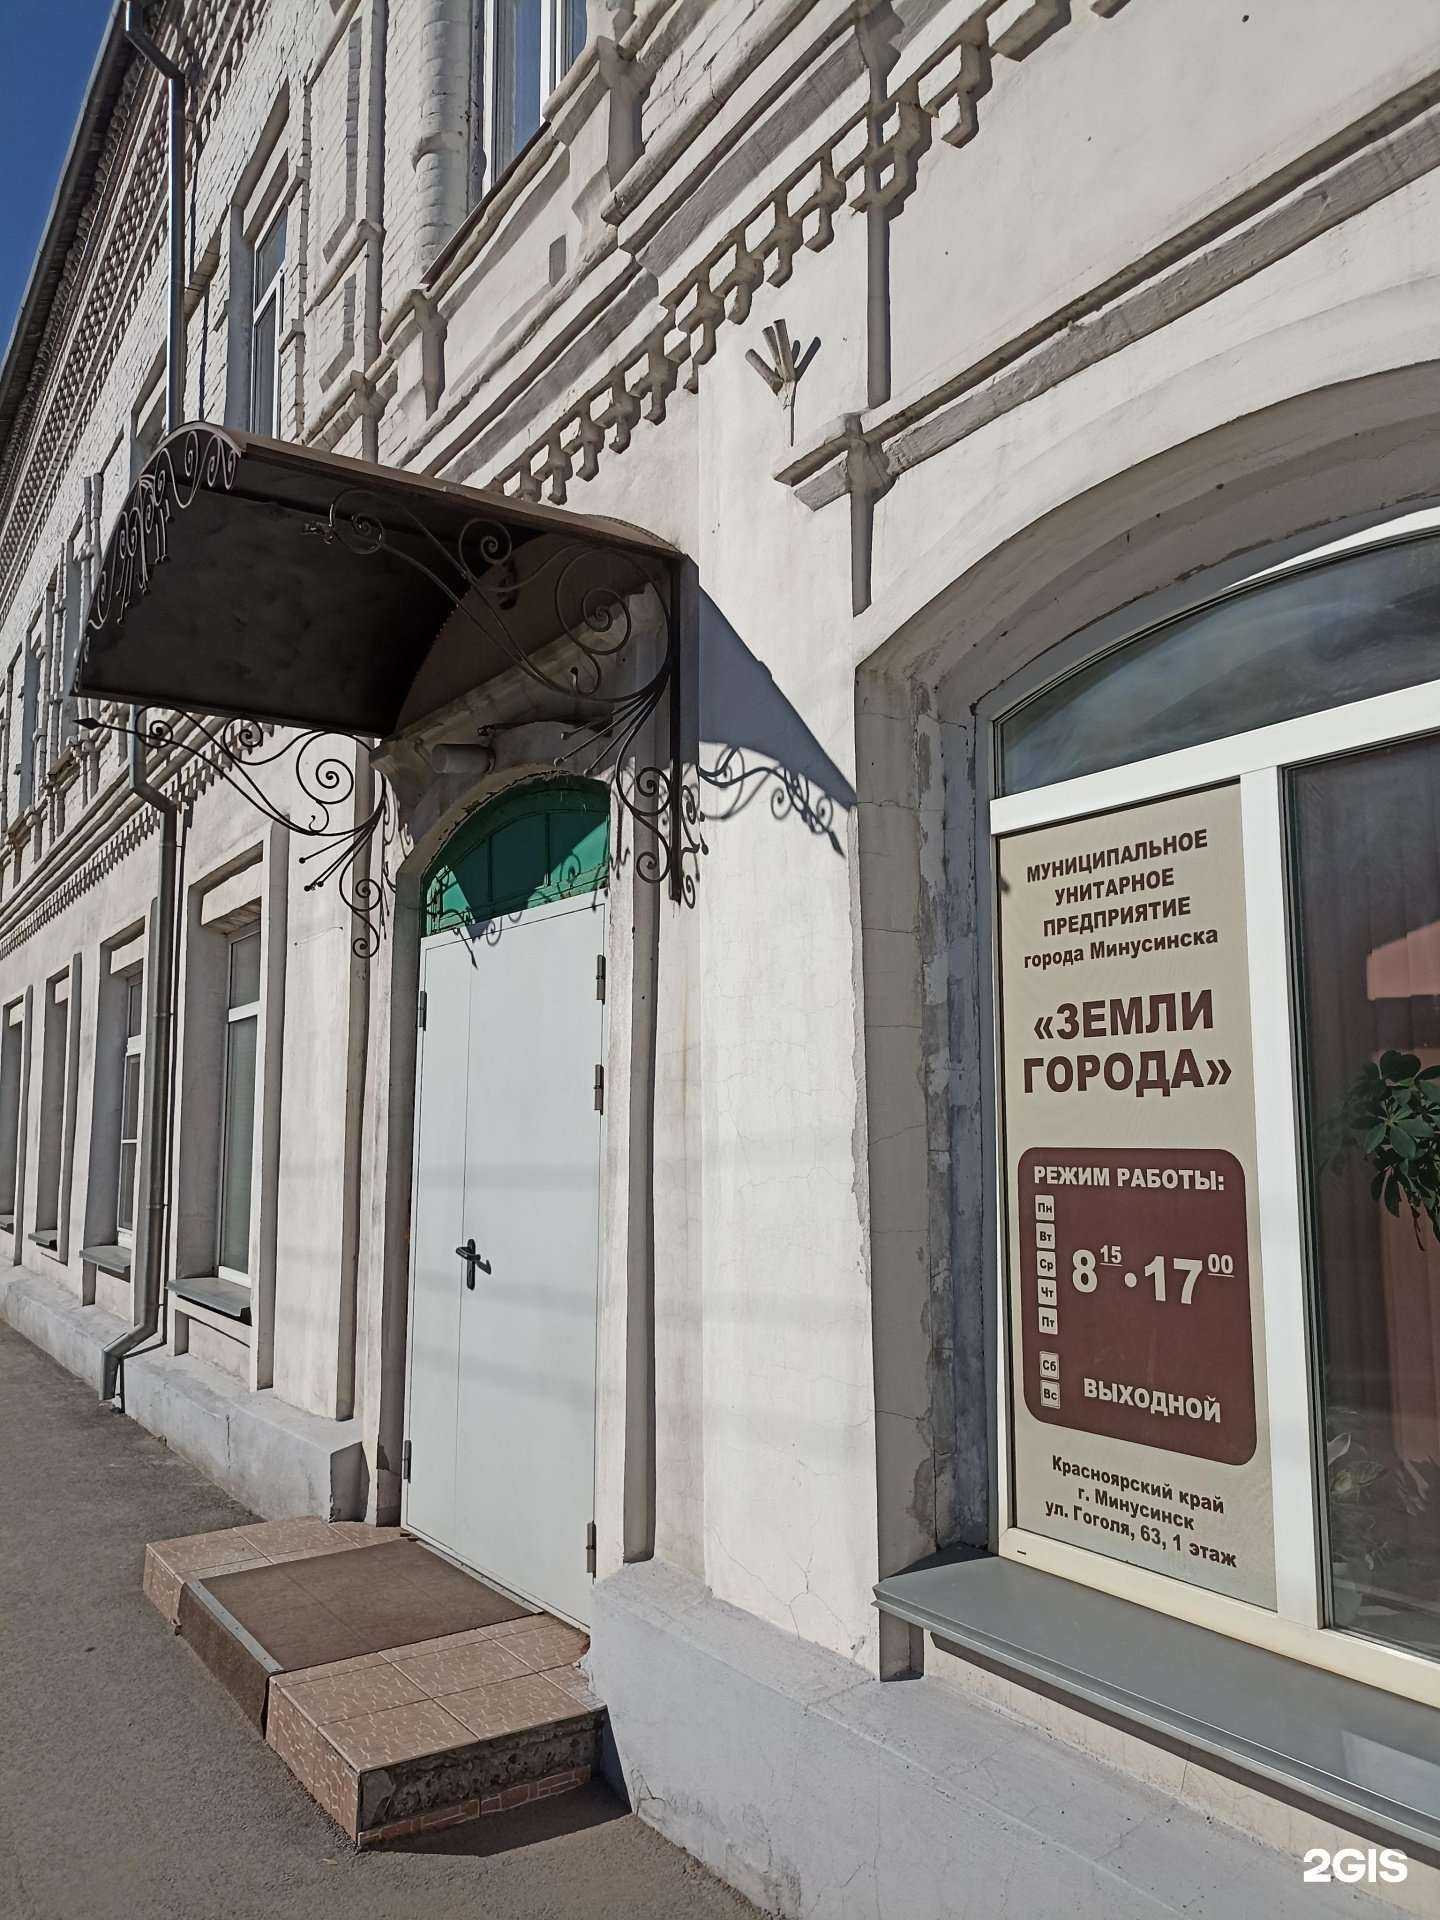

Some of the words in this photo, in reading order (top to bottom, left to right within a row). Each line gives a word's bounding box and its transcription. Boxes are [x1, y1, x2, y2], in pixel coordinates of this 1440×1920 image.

[1027, 829, 1208, 883] МУНИЦИПАЛЬНОЕ
[1055, 868, 1174, 906] УНИТАРНОЕ
[1043, 897, 1191, 936] ПРЕДПРИЯТИЕ
[1024, 948, 1084, 970] города
[1090, 928, 1218, 960] Минусинска
[1034, 989, 1213, 1040] «ЗЕМЛИ
[1023, 1049, 1232, 1097] ГОРОДА»
[1034, 1166, 1110, 1186] РЕЖИМ
[1117, 1168, 1225, 1190] РАБОТЫ:
[1038, 1202, 1052, 1214] Пн
[1039, 1231, 1052, 1241] Вт
[1039, 1258, 1054, 1271] Ср
[1041, 1287, 1054, 1298] Чт
[1042, 1317, 1055, 1328] Пт
[1043, 1360, 1057, 1372] Сб
[1044, 1388, 1057, 1399] Вс
[1084, 1378, 1221, 1423] ВЫХОДНОЙ
[1052, 1455, 1173, 1500] Красноярский
[1179, 1491, 1224, 1514] край
[1078, 1487, 1090, 1502] г.
[1095, 1488, 1195, 1530] Минусинск
[1045, 1500, 1069, 1518] ул.
[1073, 1506, 1135, 1541] Гоголя,
[1140, 1525, 1167, 1550] 63,
[1173, 1534, 1182, 1551] 1
[1189, 1541, 1237, 1568] этаж
